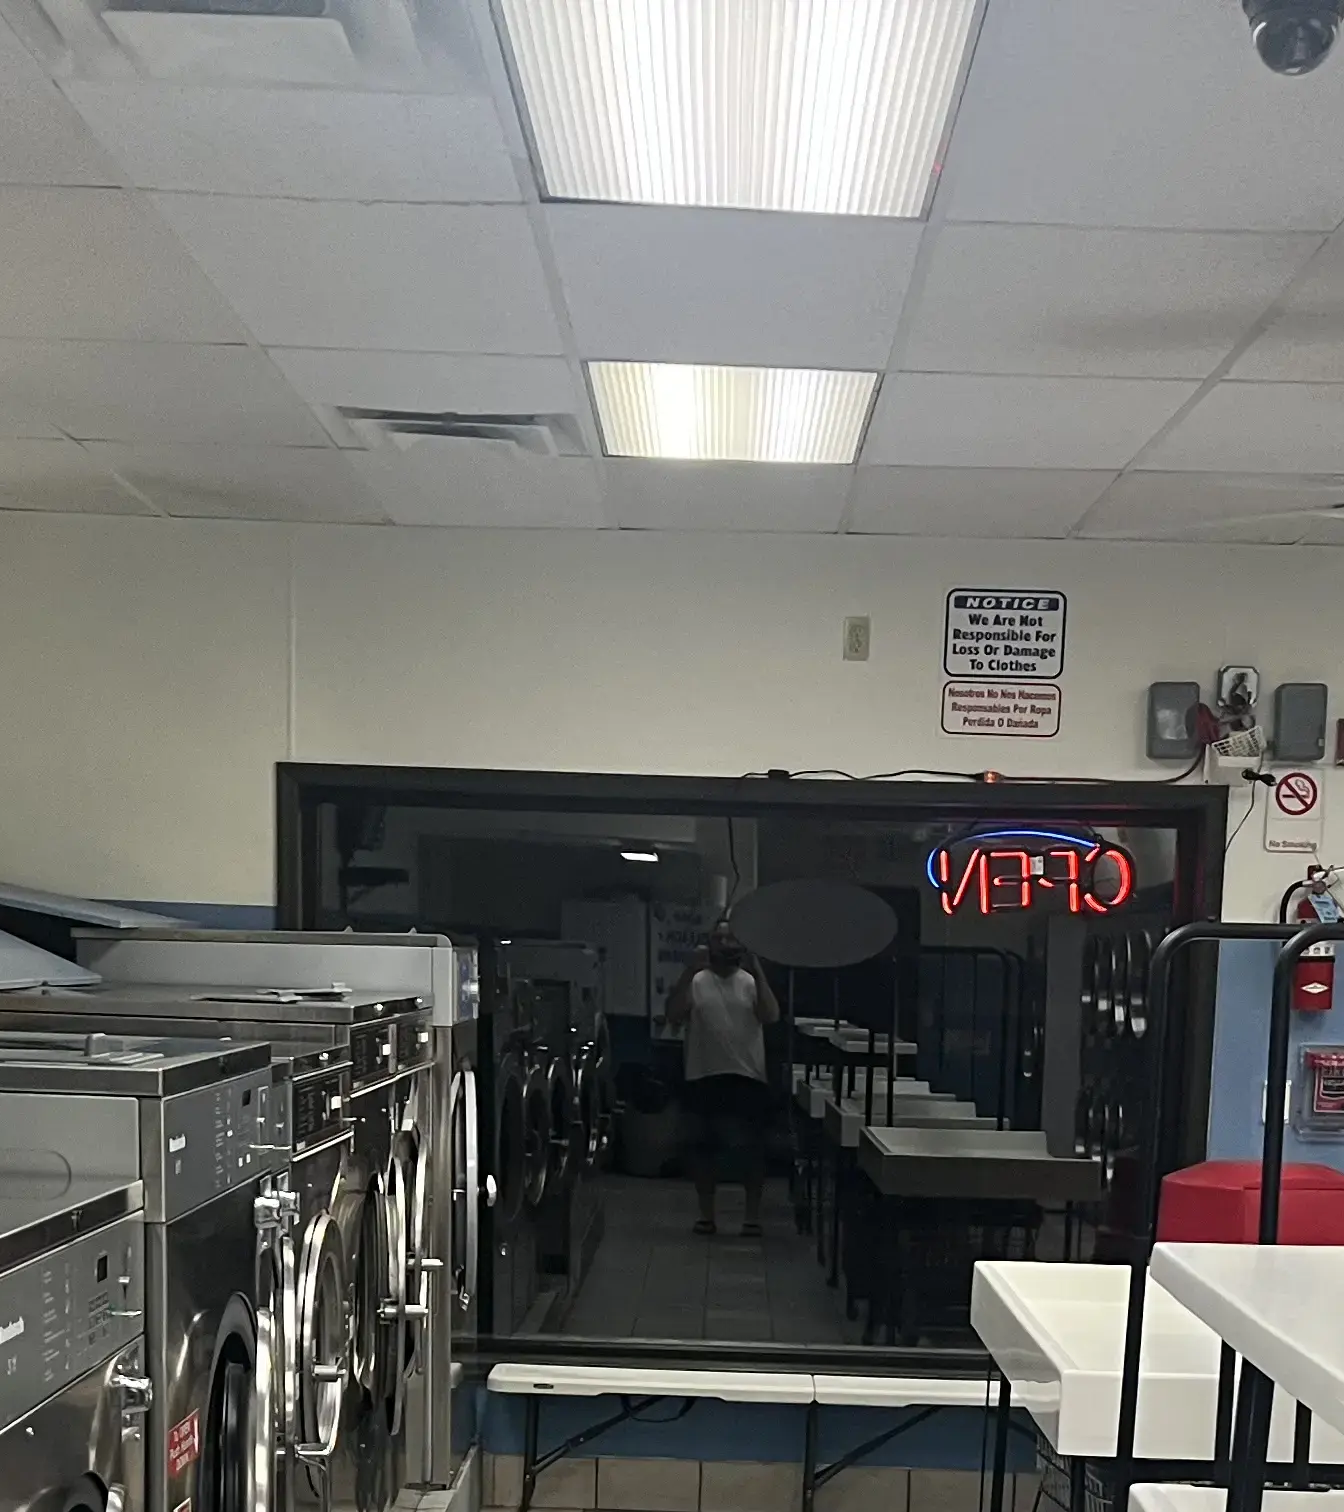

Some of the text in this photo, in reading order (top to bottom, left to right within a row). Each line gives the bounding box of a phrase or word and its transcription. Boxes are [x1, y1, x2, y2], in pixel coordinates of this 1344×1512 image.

[966, 597, 1050, 610] NOTICE
[968, 614, 1043, 627] We Are Not
[953, 629, 1056, 643] Responsible For
[952, 643, 1056, 660] Loss Or Damage
[970, 659, 1037, 672] To Clothes
[987, 689, 998, 698] No
[1030, 705, 1051, 716] Ropa
